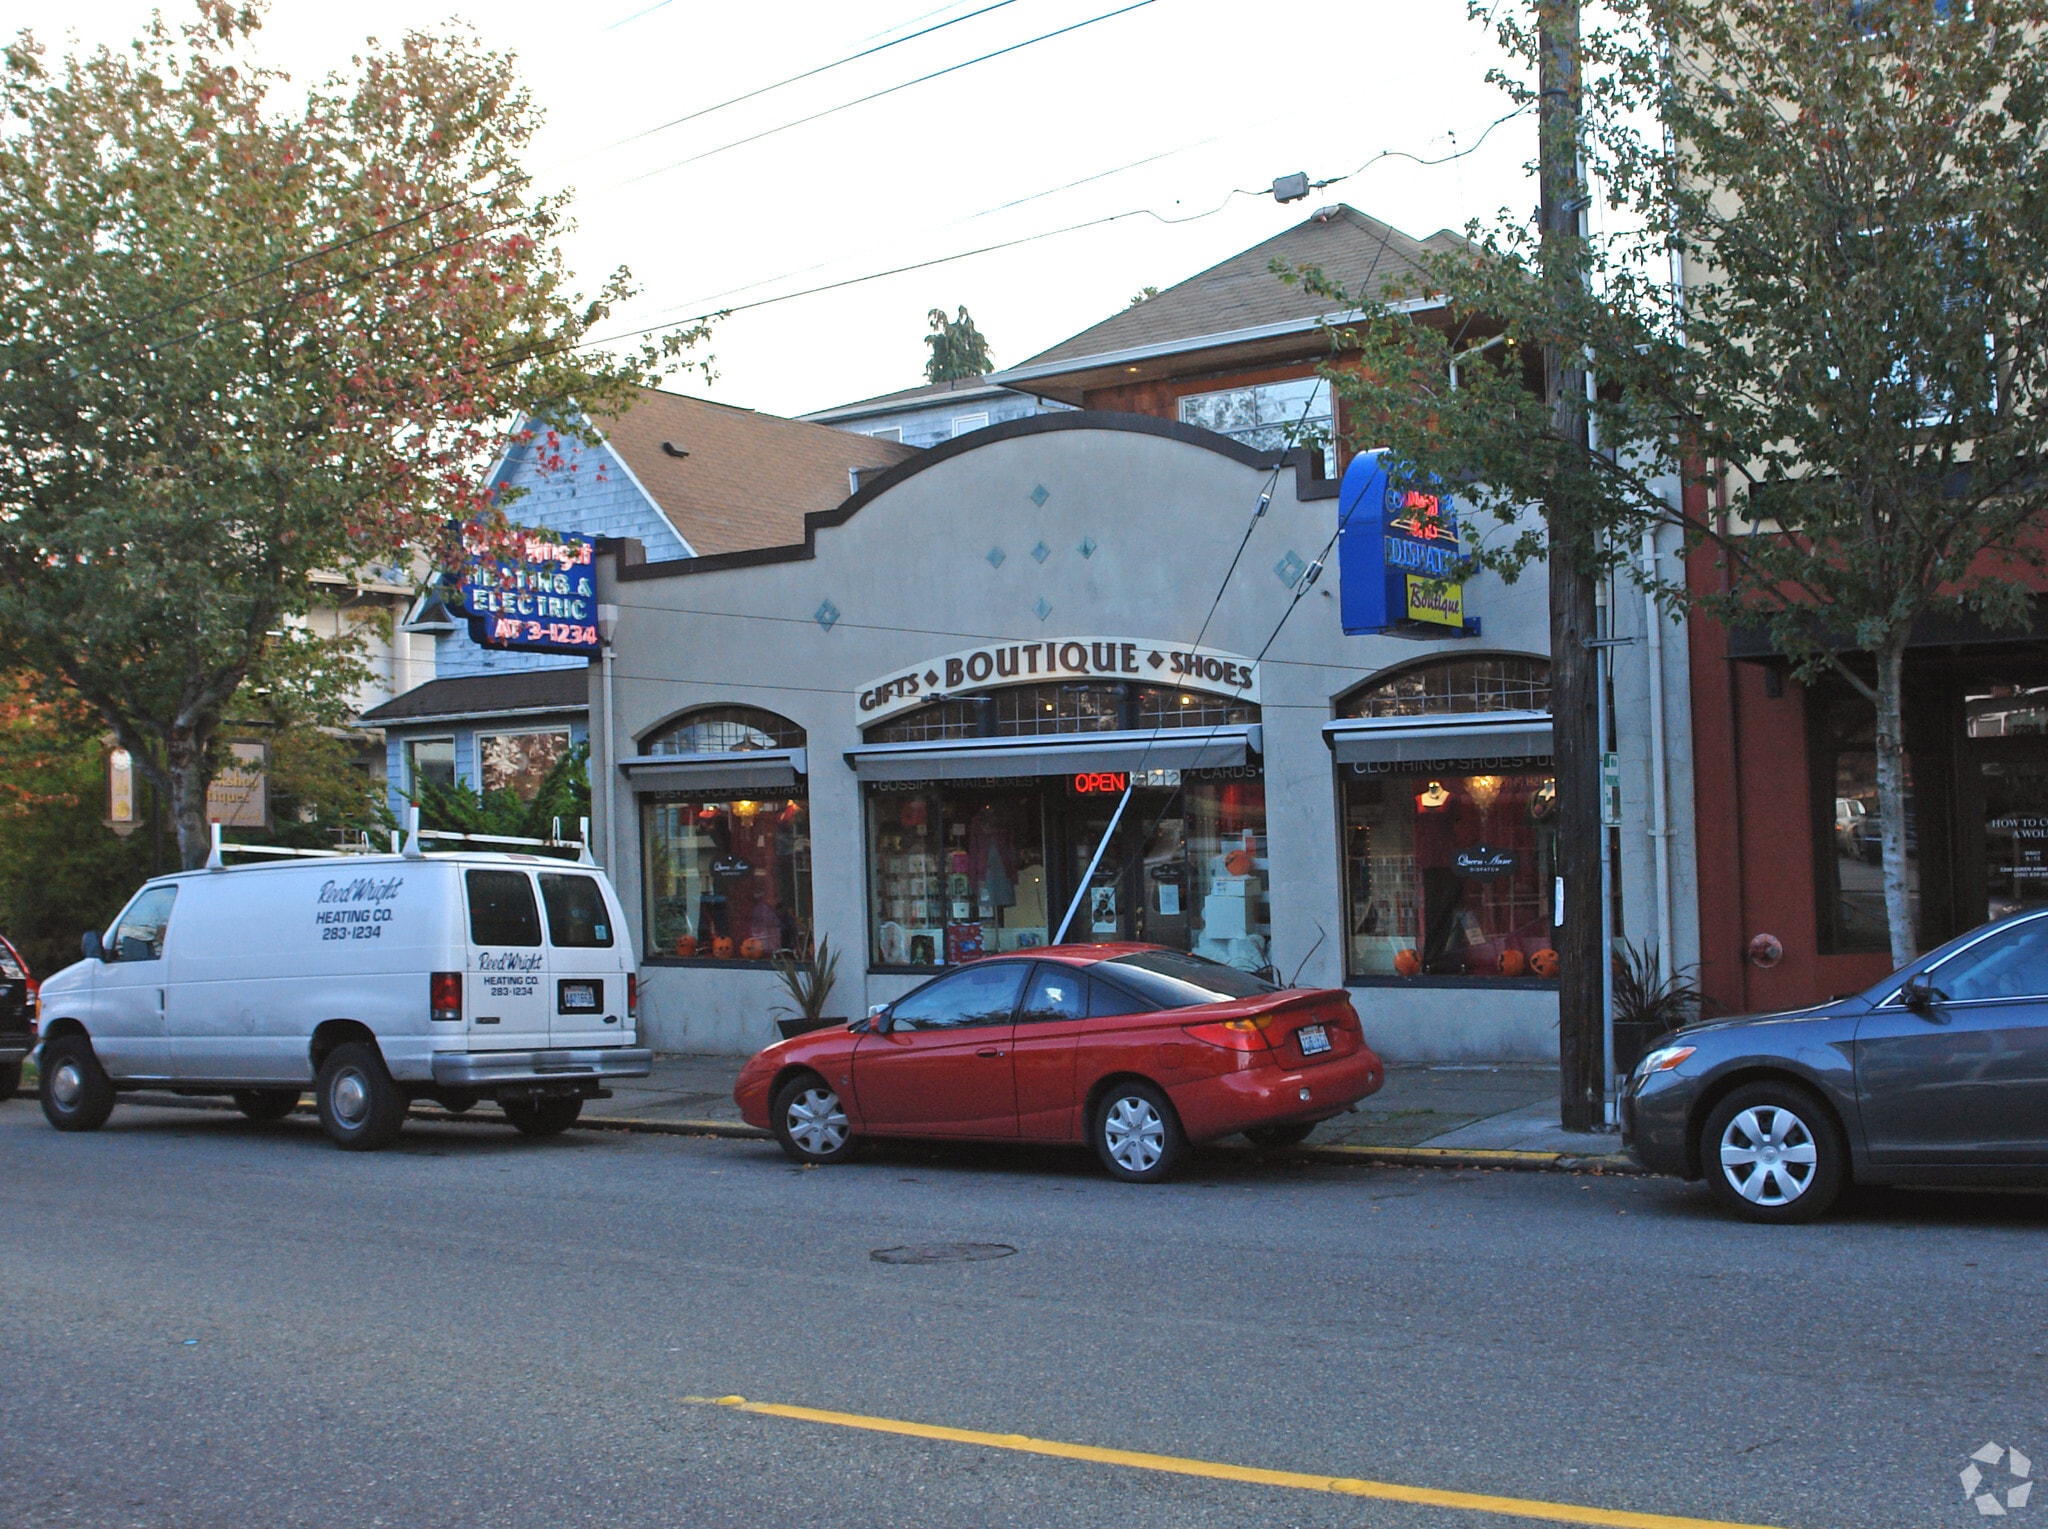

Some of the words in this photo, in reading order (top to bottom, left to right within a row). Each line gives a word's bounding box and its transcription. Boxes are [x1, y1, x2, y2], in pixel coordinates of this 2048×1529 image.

[1385, 535, 1458, 578] DISPATC
[577, 577, 593, 597] &
[472, 589, 587, 620] ELECTRIC
[494, 618, 522, 639] AT
[526, 620, 598, 645] 3-1234
[859, 672, 919, 712] GIFTS
[944, 641, 1139, 689] BOUTIQUE
[1169, 650, 1253, 690] SHOES
[1199, 763, 1256, 780] CARDS
[1353, 759, 1446, 774] CLOTHING
[1458, 757, 1524, 770] SHOES
[878, 780, 928, 792] GOSSIP
[1075, 771, 1126, 793] OPEN
[1991, 818, 2018, 828] HOW
[2021, 818, 2037, 828] TO
[2039, 817, 2048, 828] C
[2013, 830, 2020, 839] A
[2022, 829, 2048, 839] WOL
[317, 879, 352, 905] Reed
[352, 877, 404, 906] Wright
[316, 909, 370, 925] HEATING
[372, 908, 394, 922] CO.
[479, 951, 506, 971] Reed
[507, 953, 543, 974] Wright
[483, 976, 524, 986] HEATING
[525, 976, 540, 986] CO.
